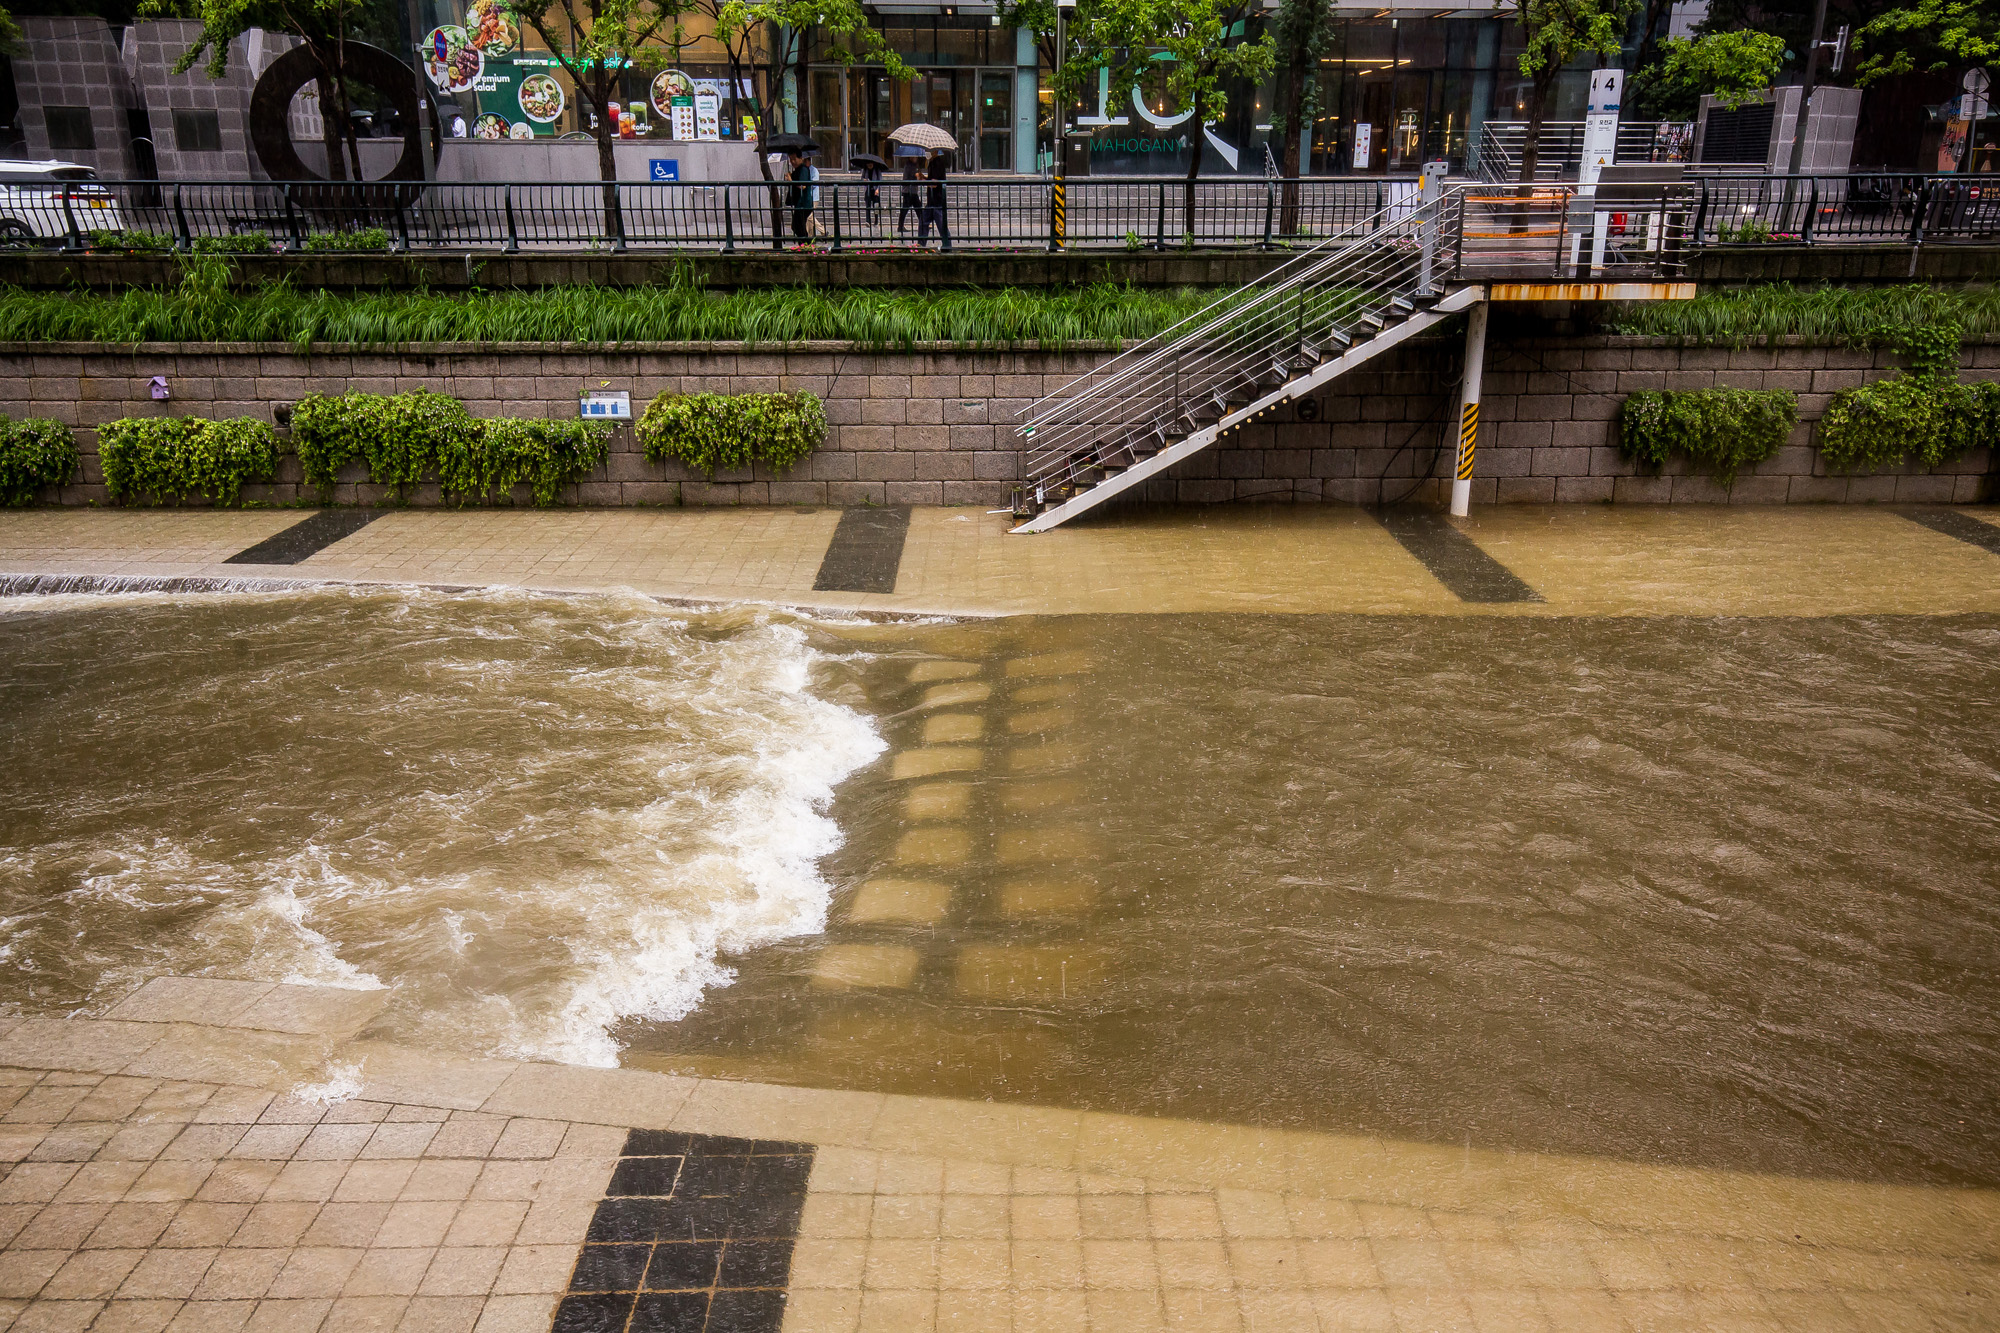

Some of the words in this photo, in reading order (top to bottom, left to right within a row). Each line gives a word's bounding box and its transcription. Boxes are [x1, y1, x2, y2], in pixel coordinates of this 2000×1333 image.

[472, 73, 511, 85] premium
[1592, 77, 1598, 92] 4
[1604, 77, 1615, 92] 4
[473, 82, 497, 92] salad
[632, 123, 653, 131] coffee
[1089, 138, 1185, 152] MAHOGANY
